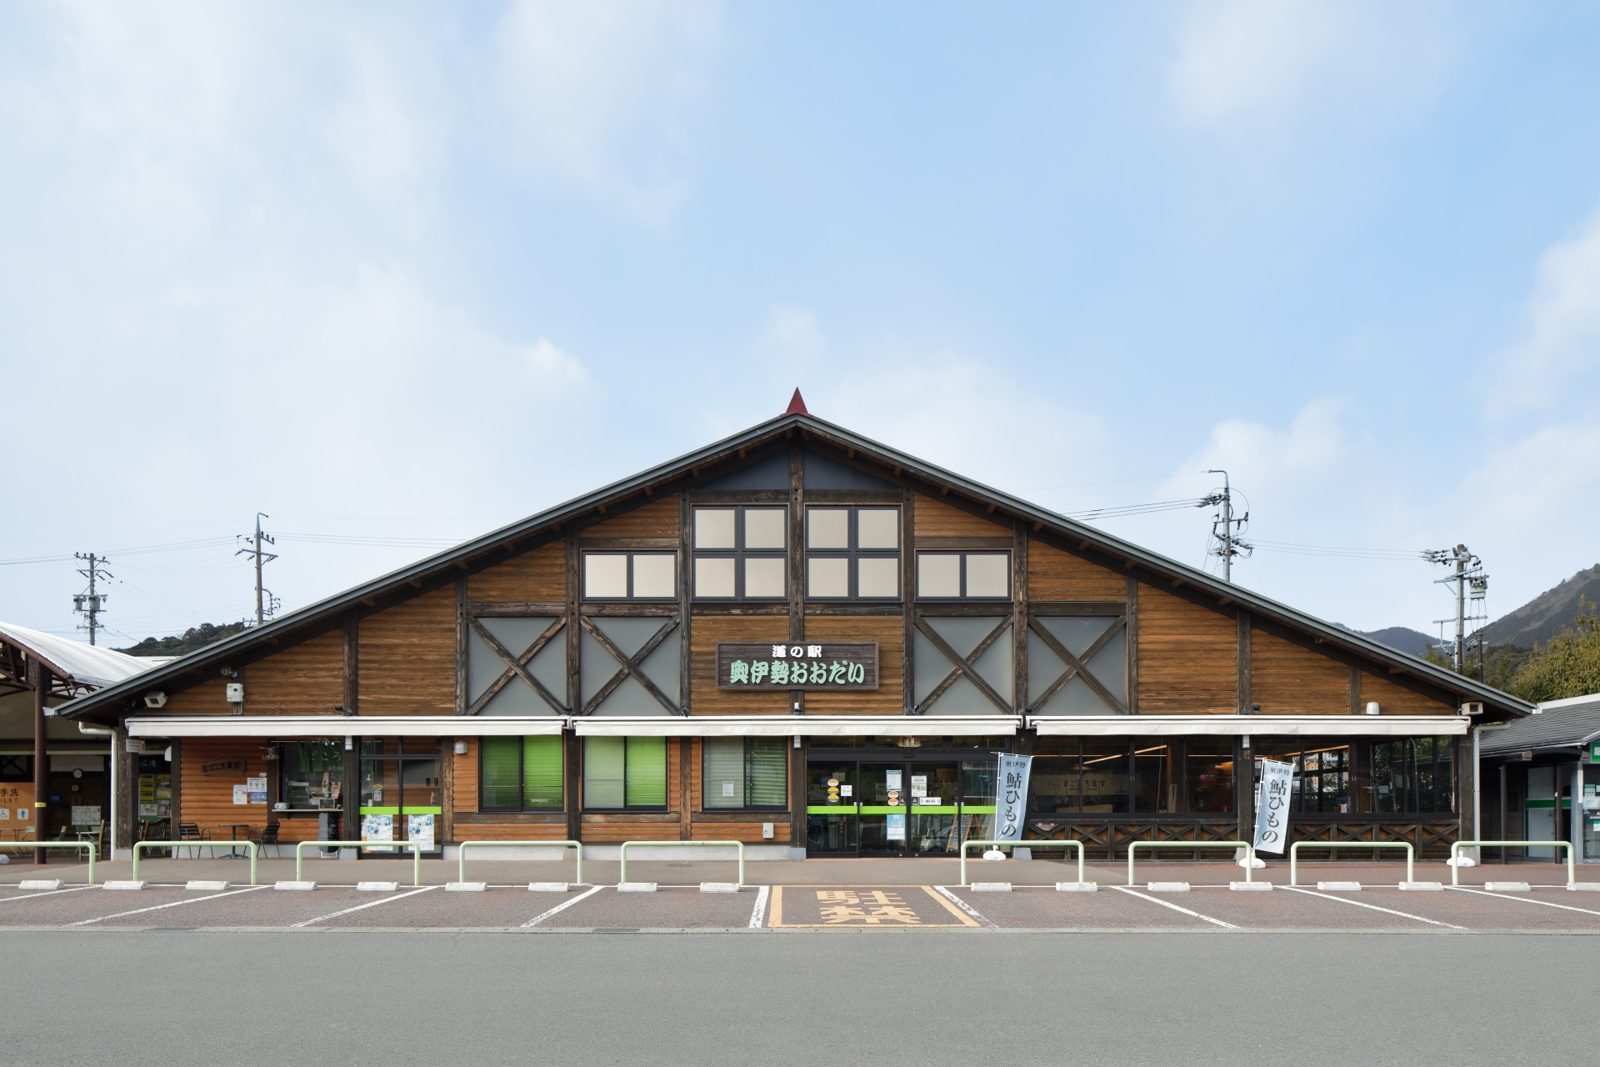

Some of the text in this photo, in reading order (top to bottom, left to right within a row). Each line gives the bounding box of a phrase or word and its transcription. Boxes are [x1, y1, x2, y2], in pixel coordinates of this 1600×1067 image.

[729, 660, 865, 685] 奥伊勢おおだい
[772, 645, 822, 658] 道の駅
[1001, 772, 1022, 837] 鮎ひもの
[1262, 779, 1287, 843] 鮎ひもの
